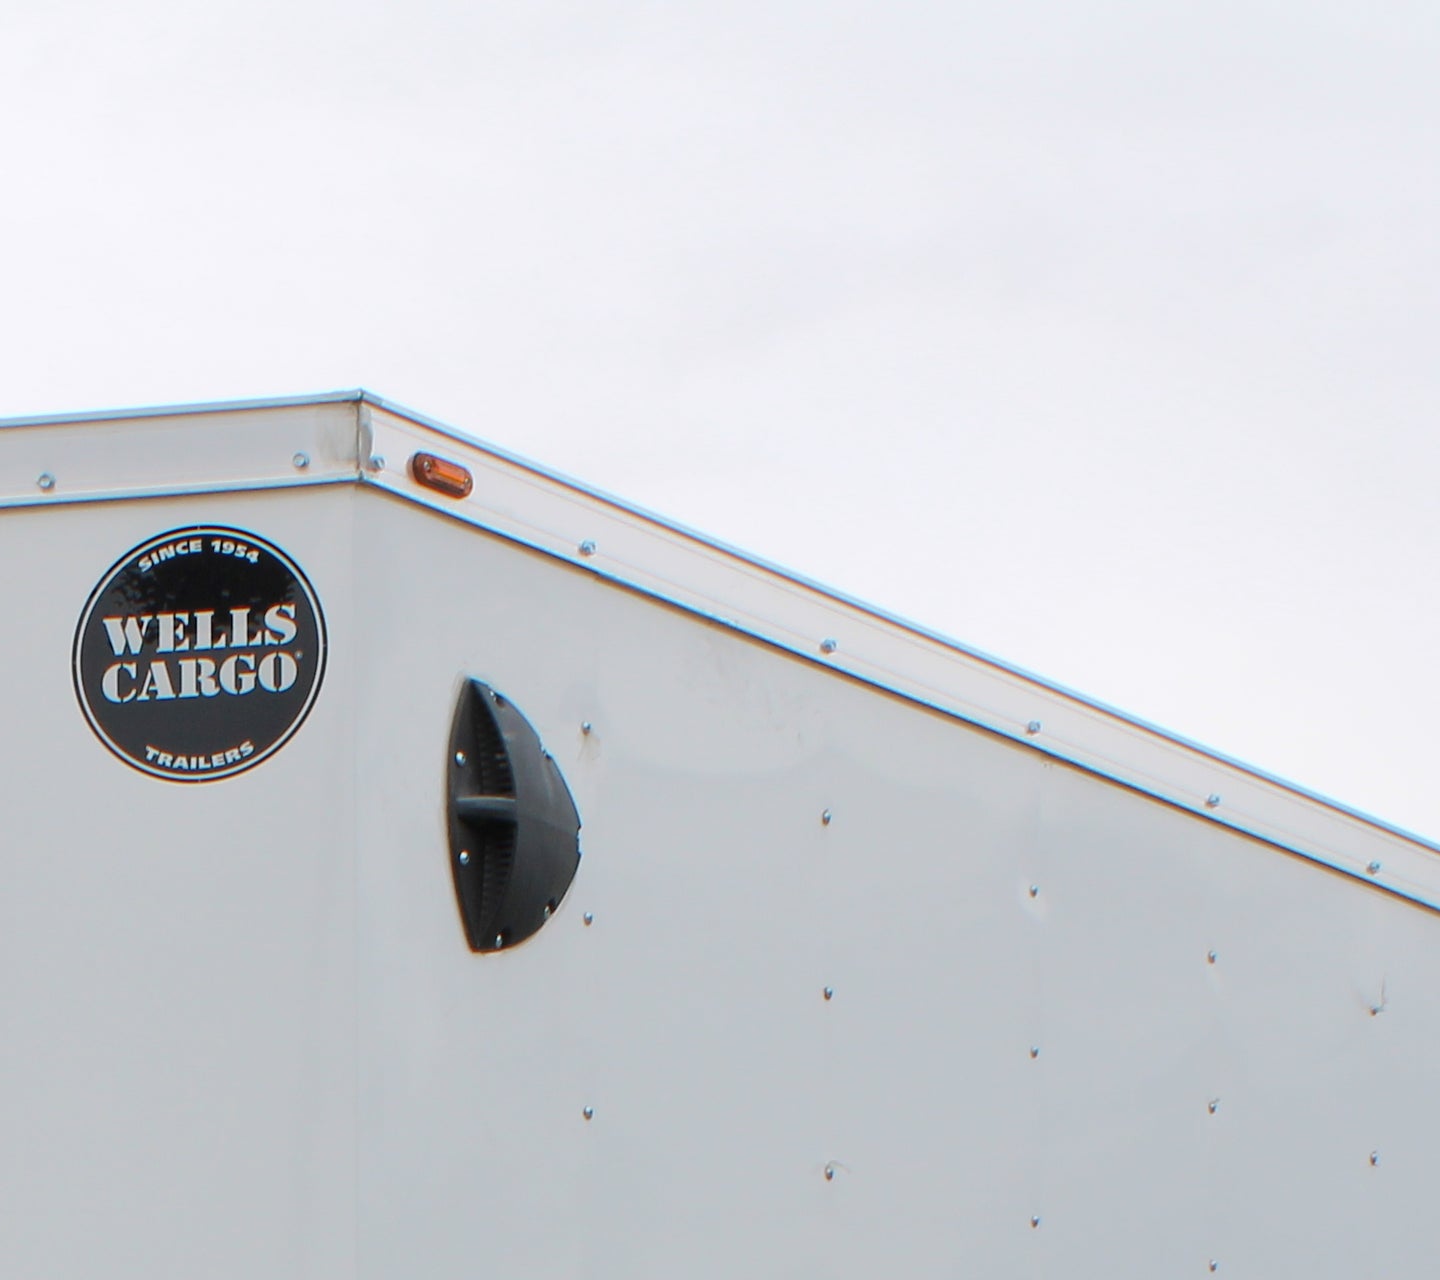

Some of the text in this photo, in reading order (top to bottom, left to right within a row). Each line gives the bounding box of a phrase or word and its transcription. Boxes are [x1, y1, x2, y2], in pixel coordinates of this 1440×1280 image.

[138, 539, 260, 571] SINCE 1954
[103, 603, 298, 656] WELLS
[101, 652, 298, 704] CARGO
[145, 741, 255, 770] TRAILERS
